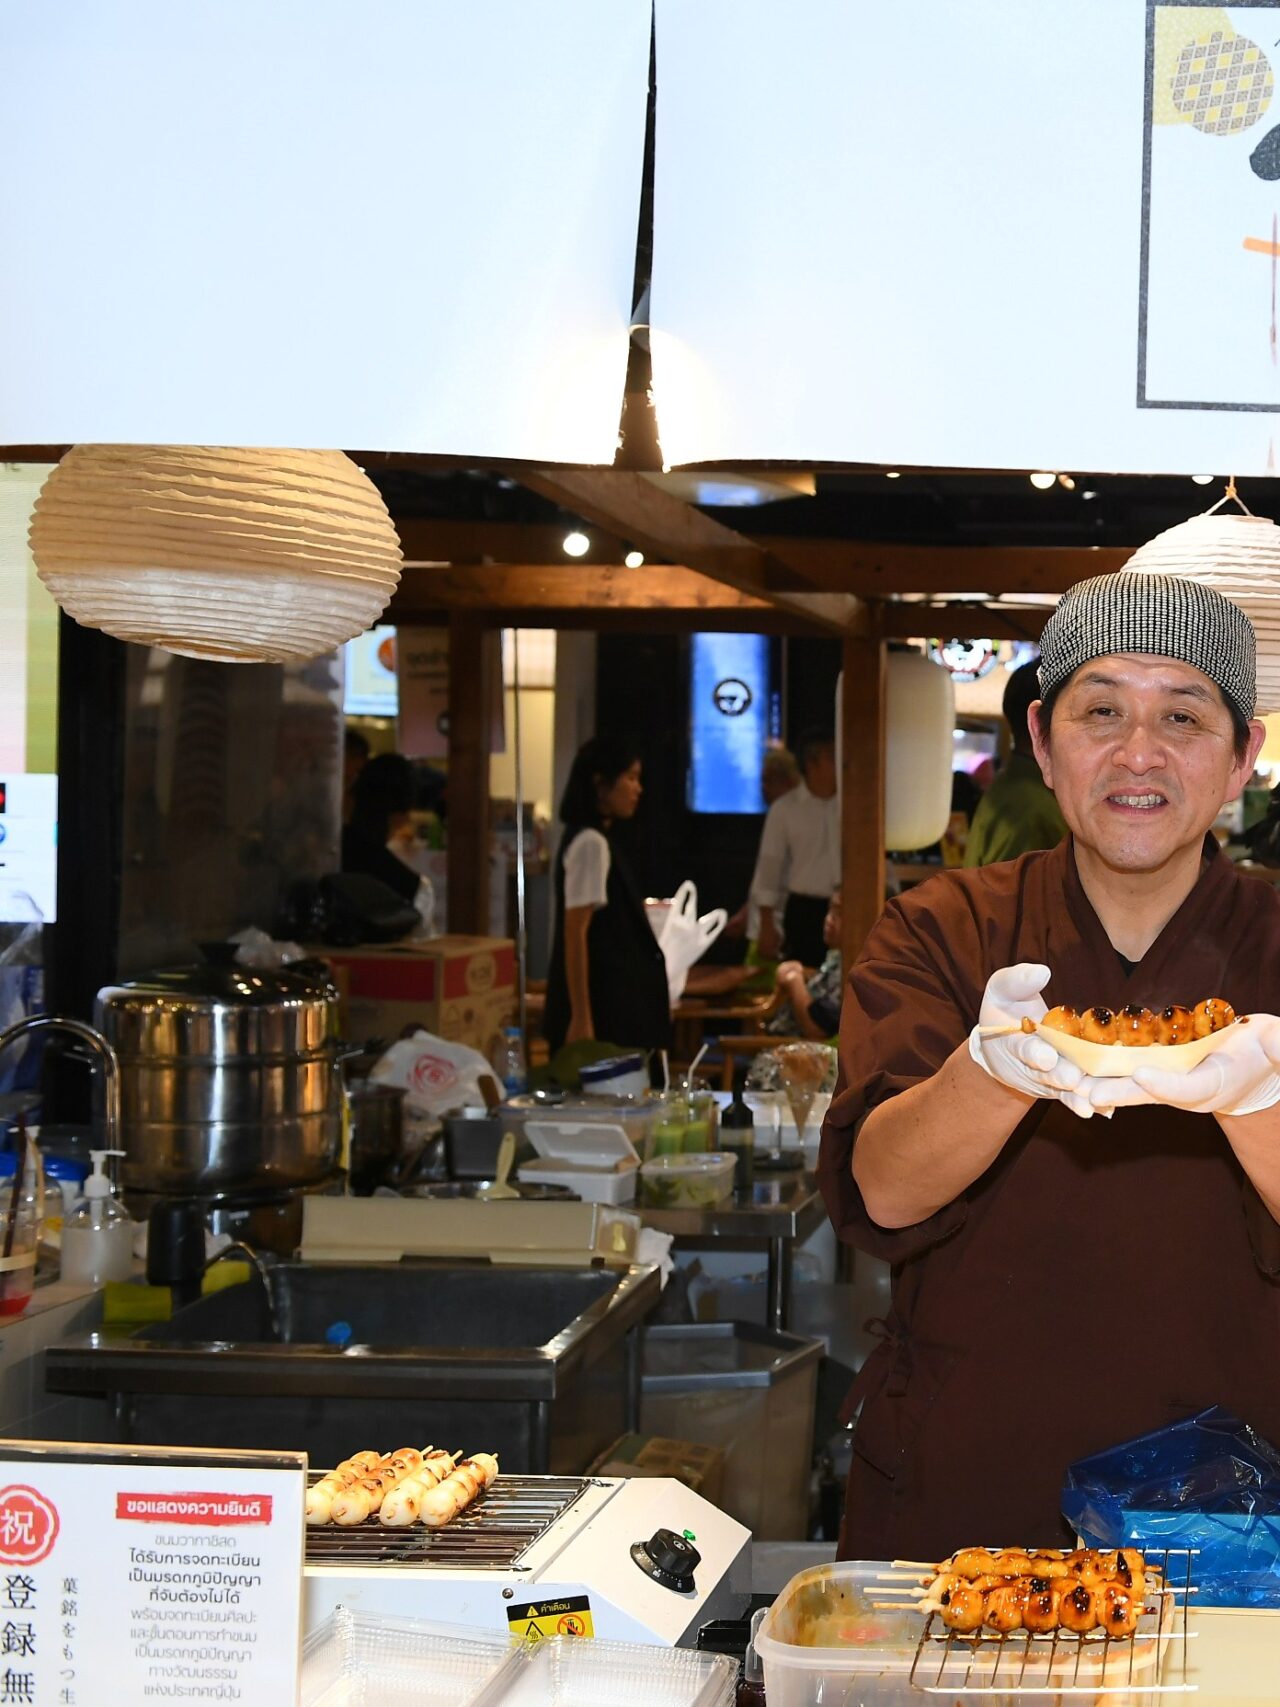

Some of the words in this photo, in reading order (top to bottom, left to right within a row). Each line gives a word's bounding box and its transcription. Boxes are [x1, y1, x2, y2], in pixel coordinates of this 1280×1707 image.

[127, 1500, 261, 1518] ขอแสดงความยินดี
[0, 1509, 36, 1546] 祝
[155, 1534, 236, 1548] ขนมวากาชิสด
[129, 1548, 261, 1567] ได้รับการจดทะเบียน
[128, 1568, 261, 1588] เป็นมรดกภูมิปัญญา
[149, 1585, 241, 1604] ที่จับต้องไม่ได้
[131, 1607, 257, 1624] พร้อมจดทะเบียนศิลปะ
[1, 1575, 37, 1705] 登録無
[130, 1625, 257, 1643] และขั้นตอนการทำขนม
[135, 1644, 252, 1663] เป็นมรดกภูมิปัญญา
[149, 1665, 238, 1680] ทางวัฒนธรรม
[144, 1683, 241, 1702] แห่งประเทศญี่ปุ่น
